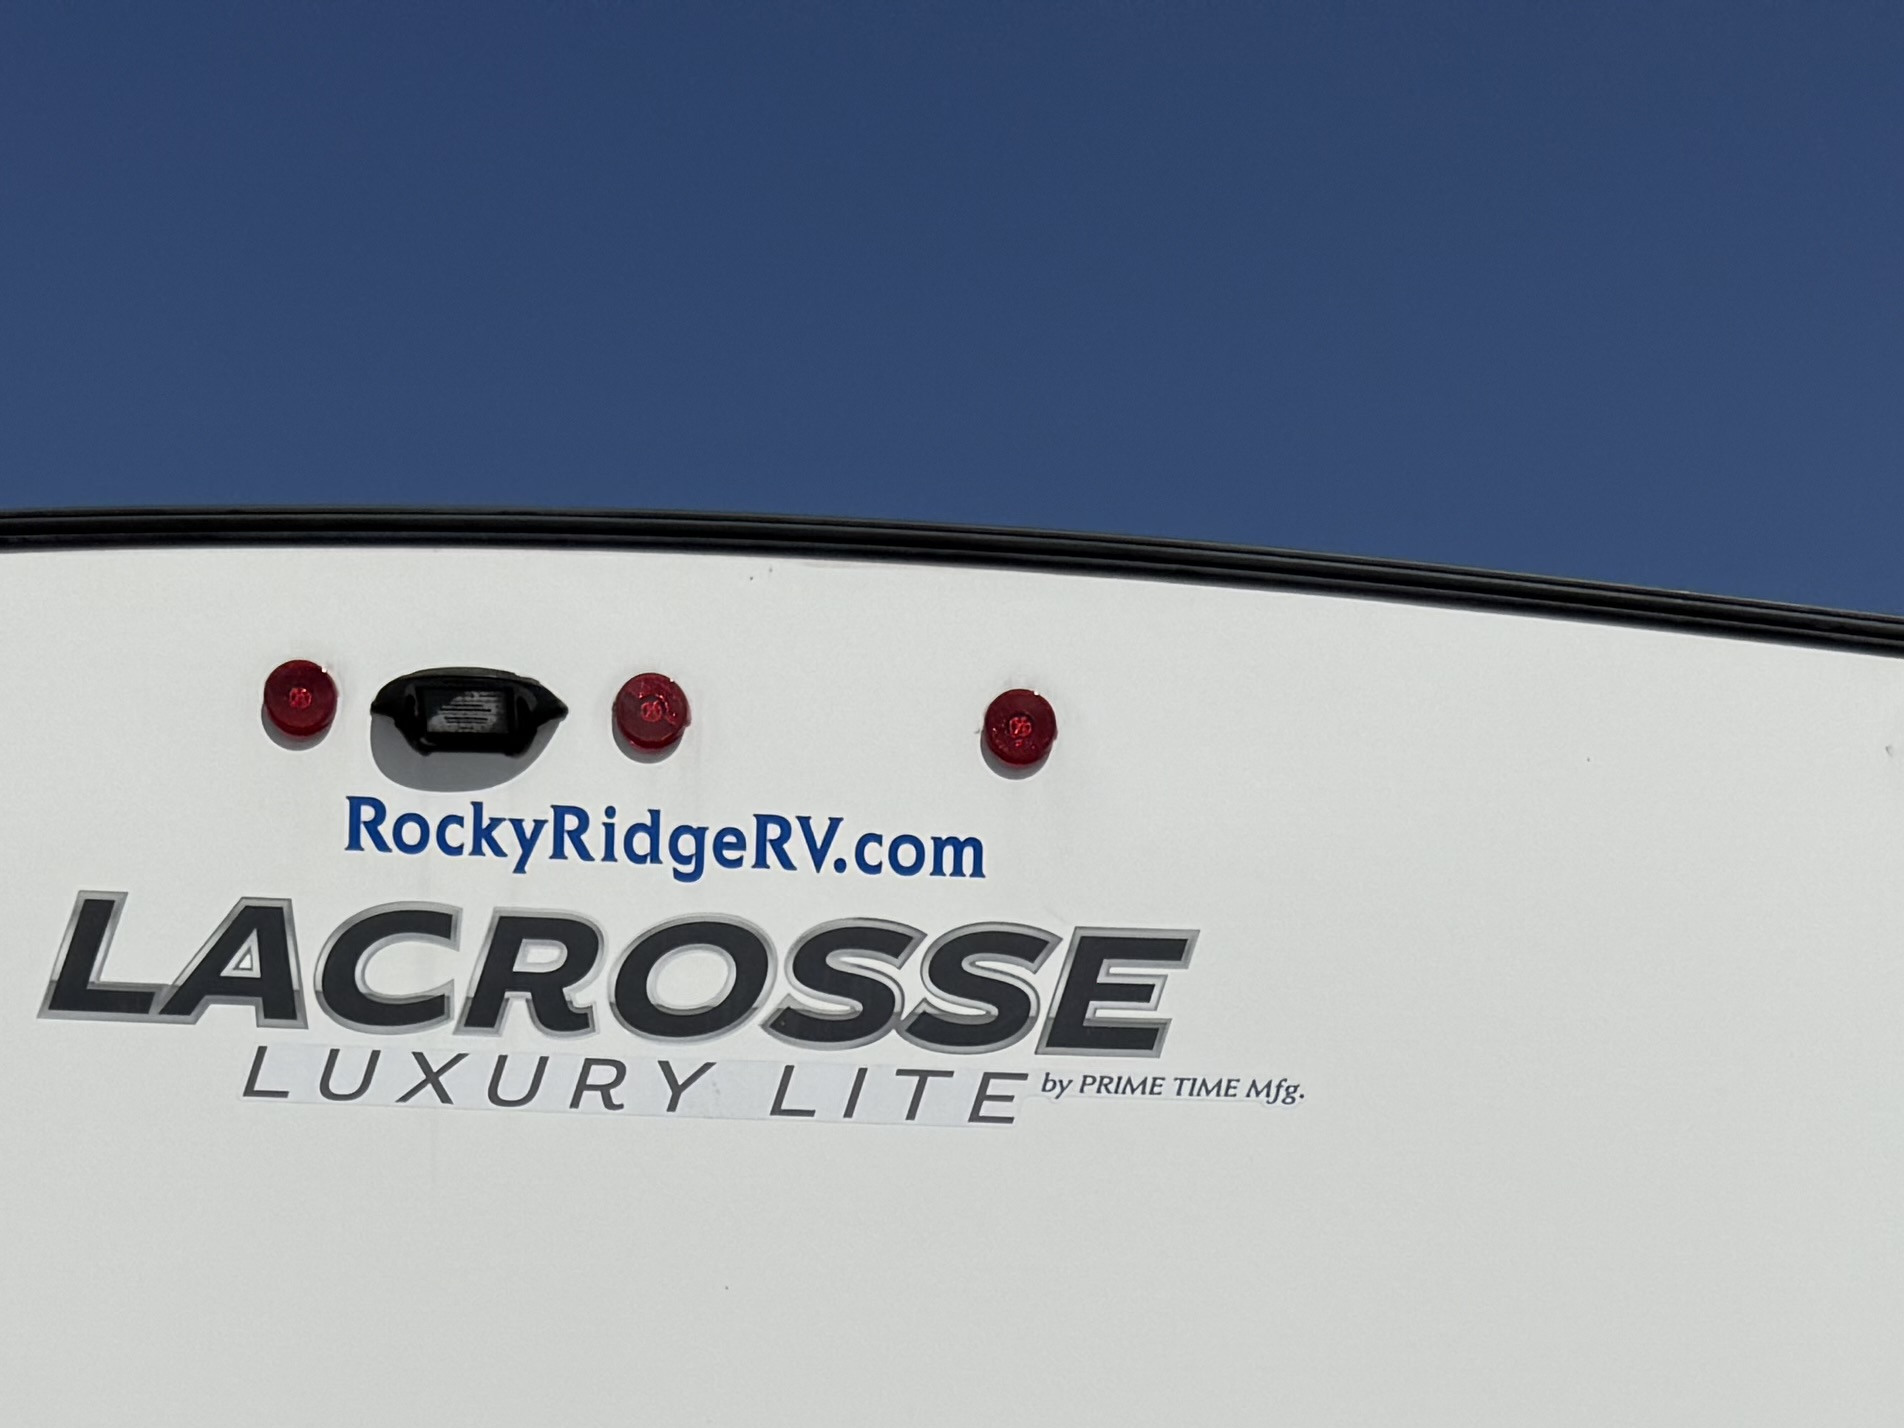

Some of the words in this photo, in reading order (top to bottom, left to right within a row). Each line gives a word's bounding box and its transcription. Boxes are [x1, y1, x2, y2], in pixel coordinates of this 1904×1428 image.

[345, 790, 986, 884] RockyRidgeRV.com
[37, 889, 1201, 1058] LACROSSE
[243, 1045, 717, 1114] LUXURY
[770, 1065, 1029, 1124] LITE
[1041, 1072, 1073, 1099] by
[1079, 1074, 1166, 1096] PRIME
[1173, 1077, 1241, 1098] TIME
[1245, 1078, 1305, 1105] Mfg.
